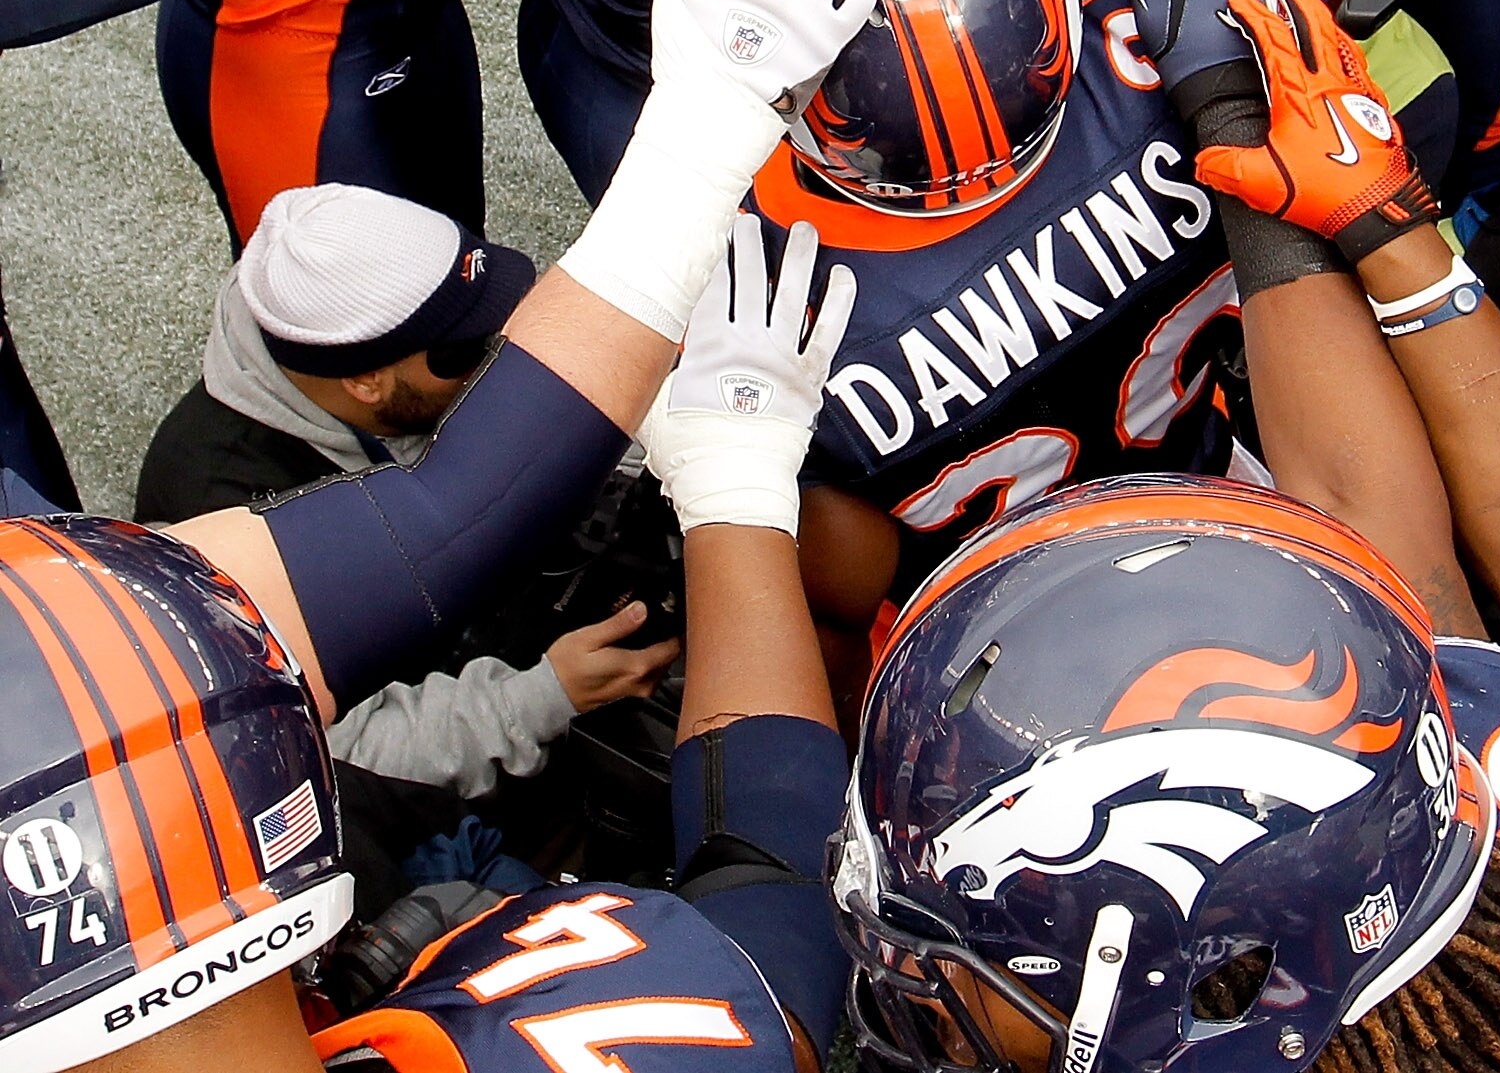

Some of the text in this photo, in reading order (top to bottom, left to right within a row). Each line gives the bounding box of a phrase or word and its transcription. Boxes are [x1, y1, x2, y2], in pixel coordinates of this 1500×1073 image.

[731, 11, 779, 40] EQUIPMENT
[827, 141, 1212, 456] DAWKINS
[724, 377, 771, 391] EQUIPMENT
[24, 896, 108, 966] 74
[103, 910, 316, 1034] BRONCOS
[1011, 961, 1059, 971] SPEED
